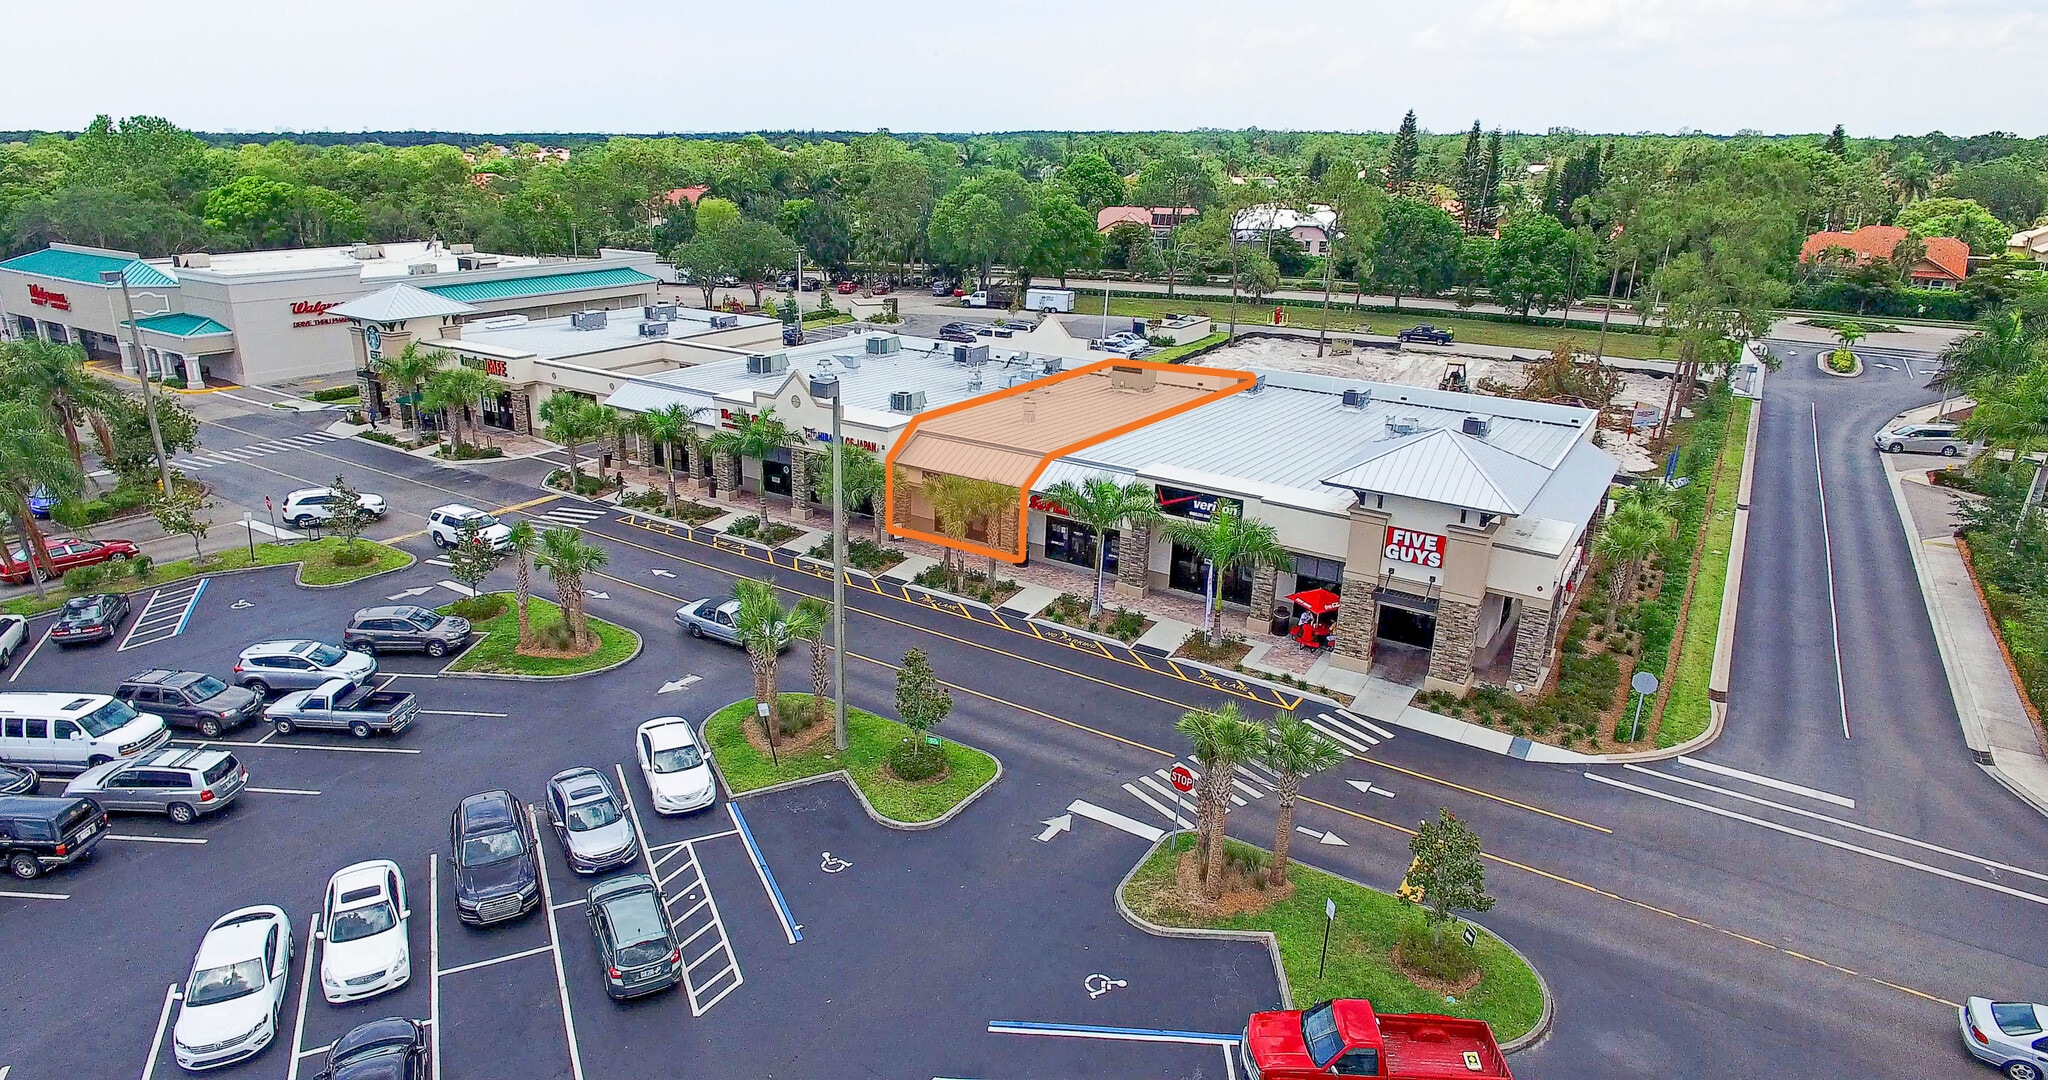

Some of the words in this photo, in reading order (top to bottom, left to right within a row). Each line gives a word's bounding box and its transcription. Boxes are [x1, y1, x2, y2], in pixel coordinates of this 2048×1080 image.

[855, 438, 878, 453] JAPAN
[1193, 499, 1238, 516] verion
[1392, 529, 1438, 552] FIVE
[1385, 543, 1441, 568] GUYS
[1198, 674, 1220, 683] FIRE
[1222, 681, 1251, 692] LANE
[1171, 771, 1193, 787] STOP
